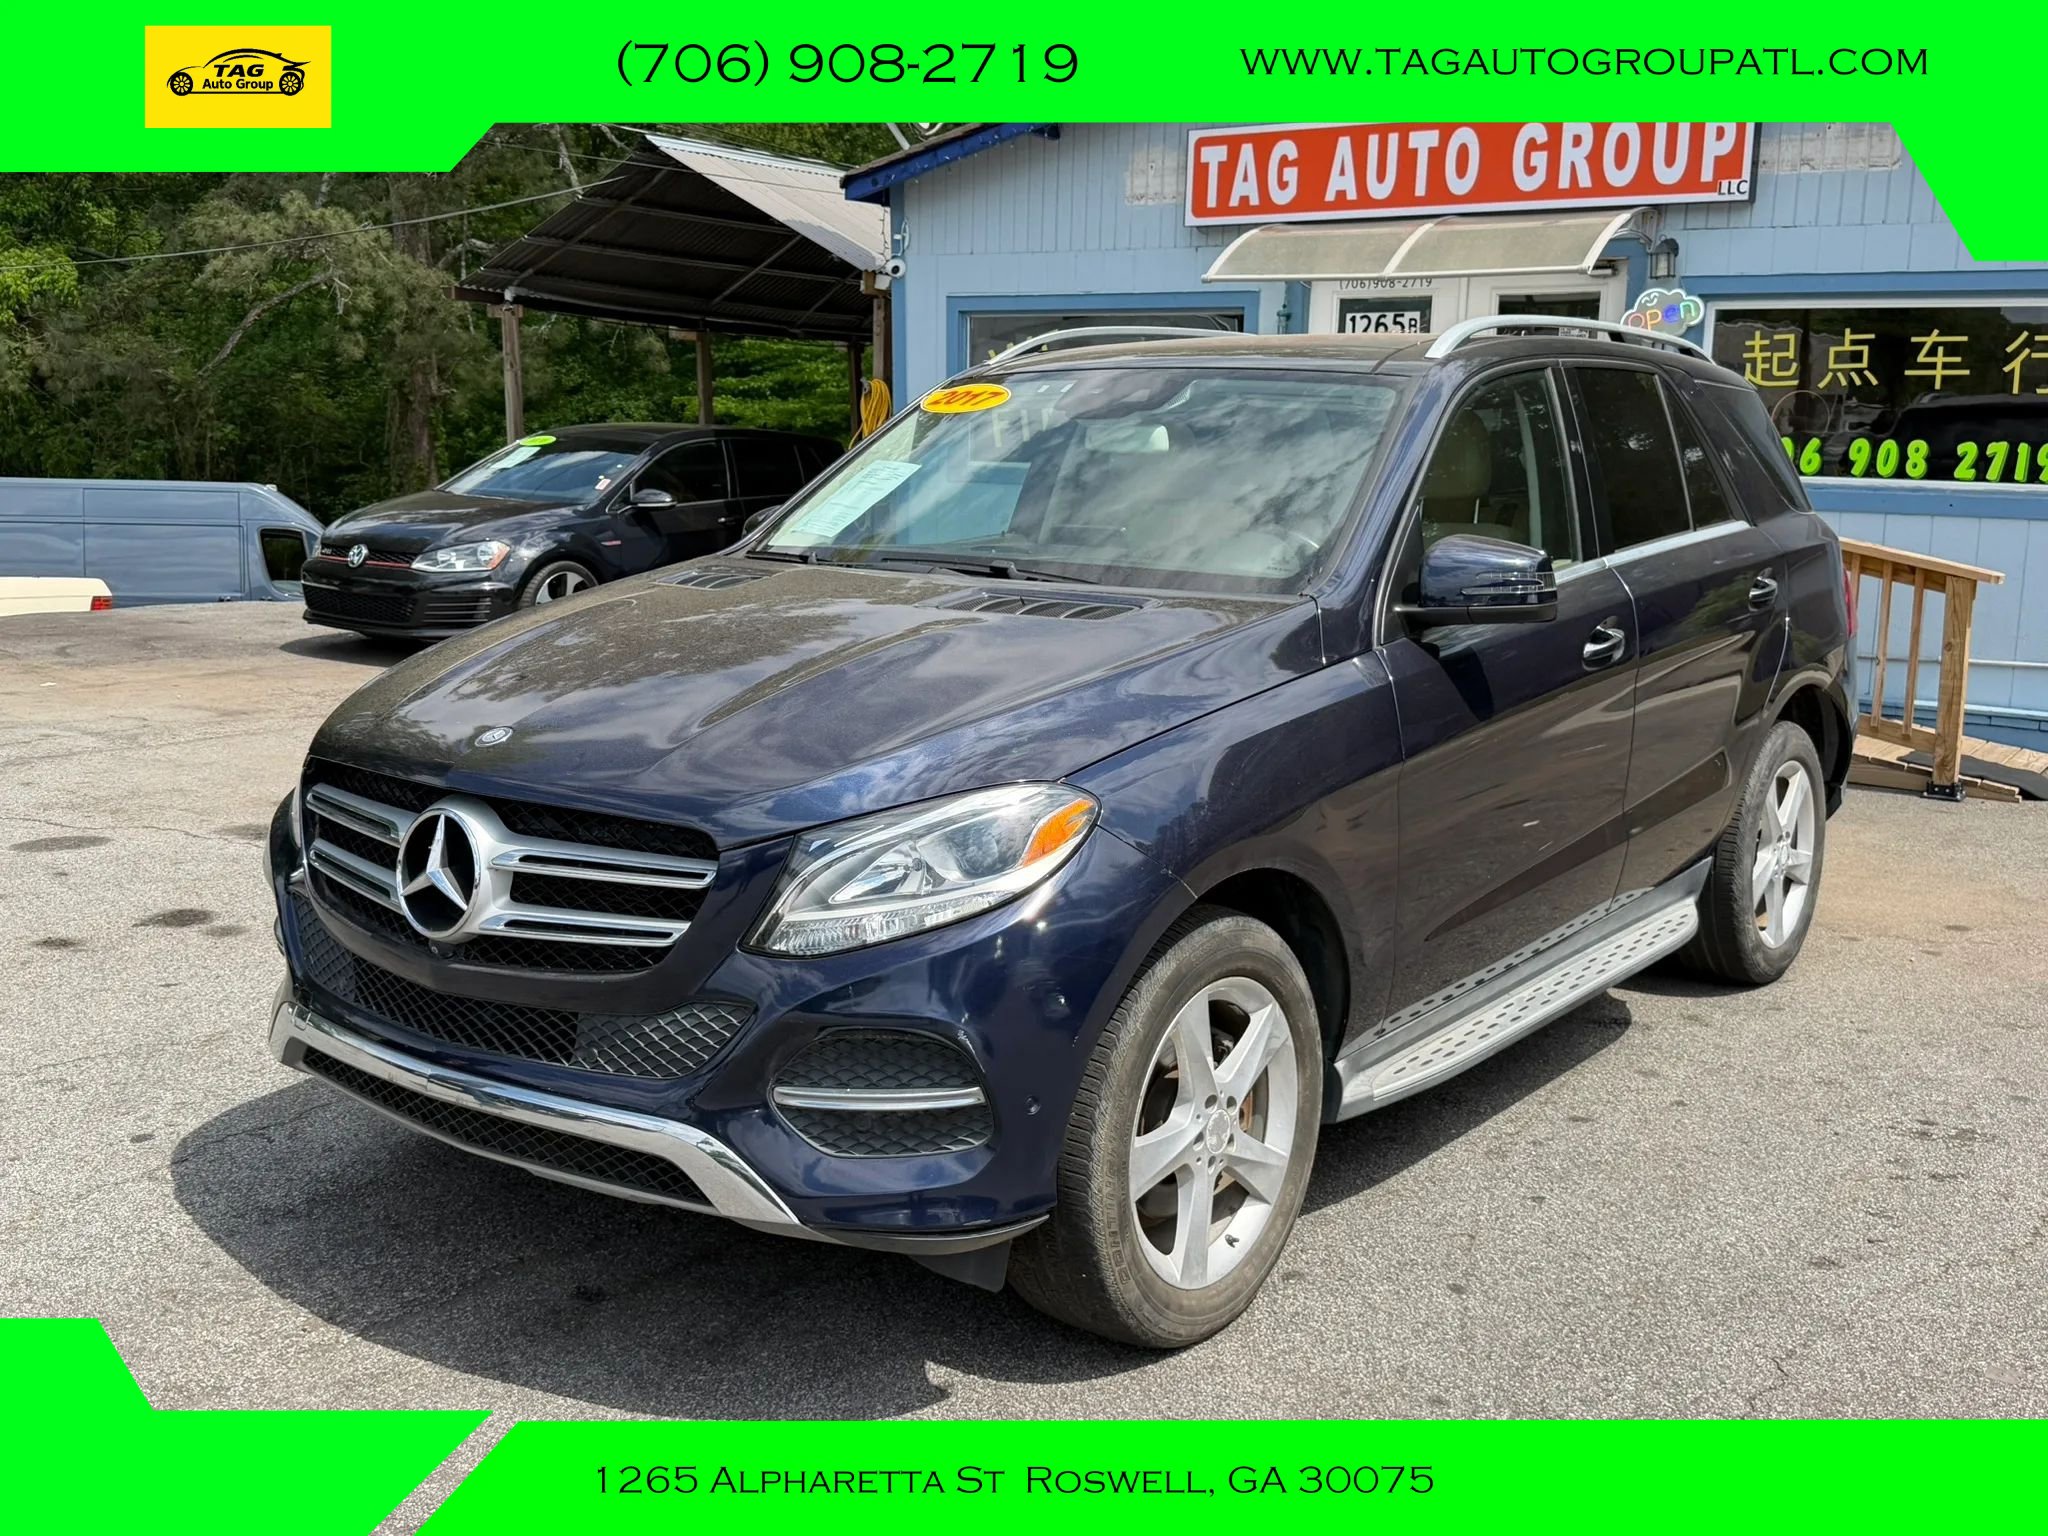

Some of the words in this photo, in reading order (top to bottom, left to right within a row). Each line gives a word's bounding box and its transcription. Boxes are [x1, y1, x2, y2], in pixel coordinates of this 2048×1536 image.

[1200, 139, 1299, 209] TAG
[1324, 126, 1481, 203] AUTO
[1511, 122, 1738, 192] GROUP
[1717, 179, 1750, 196] LLC
[928, 389, 1005, 407] 2017
[1848, 437, 1931, 480] 908
